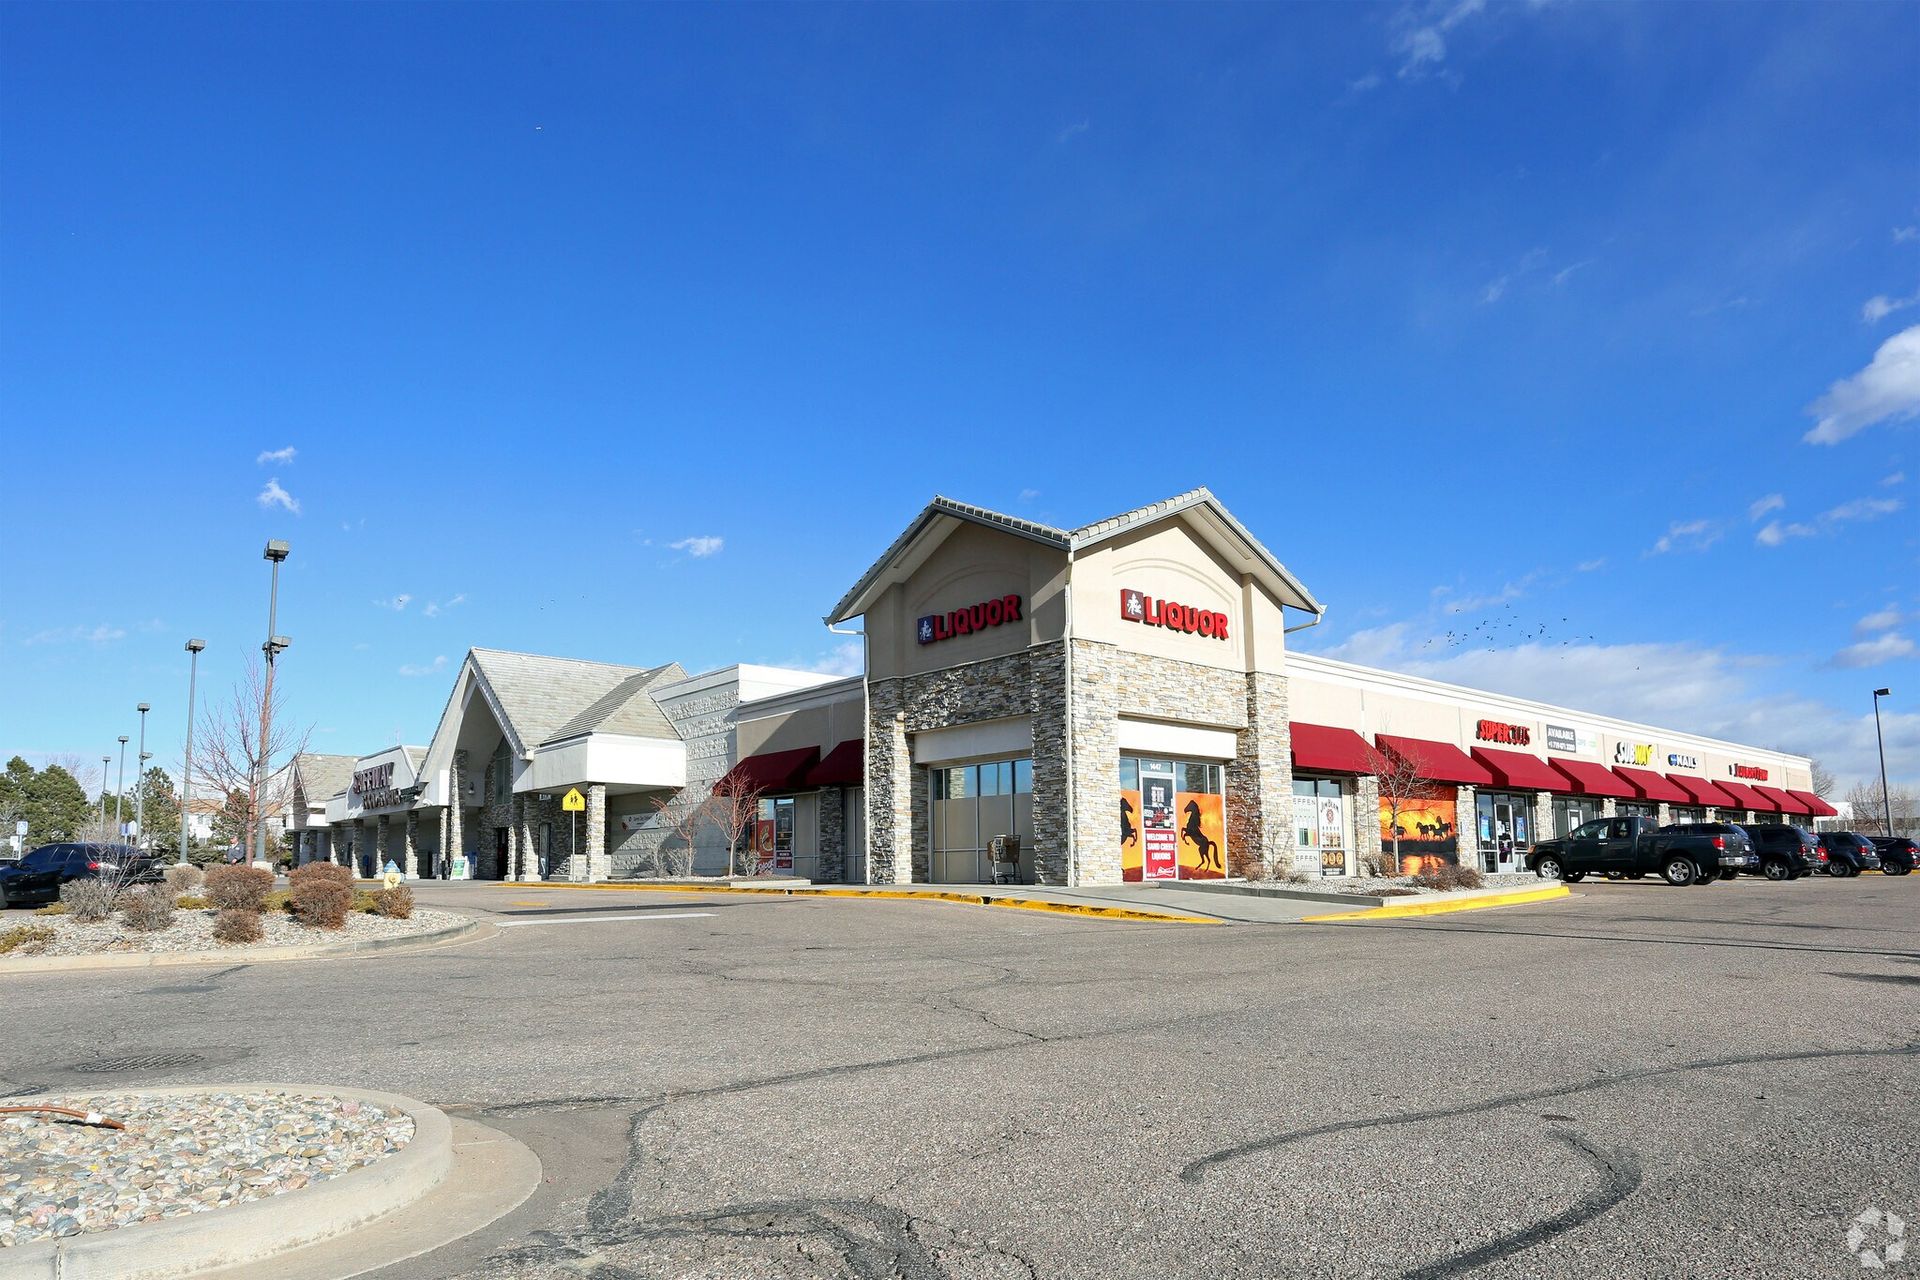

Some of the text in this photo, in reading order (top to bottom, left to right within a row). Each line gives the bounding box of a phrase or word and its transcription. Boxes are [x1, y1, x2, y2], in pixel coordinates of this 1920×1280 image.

[933, 594, 1021, 641] LIQUOR
[1143, 596, 1229, 640] LIQUOR
[1477, 719, 1530, 746] SUPERCUTS
[1547, 727, 1574, 741] AVAILABLE
[1615, 740, 1653, 765] SUBWAY
[353, 762, 394, 794] SAFEWAY
